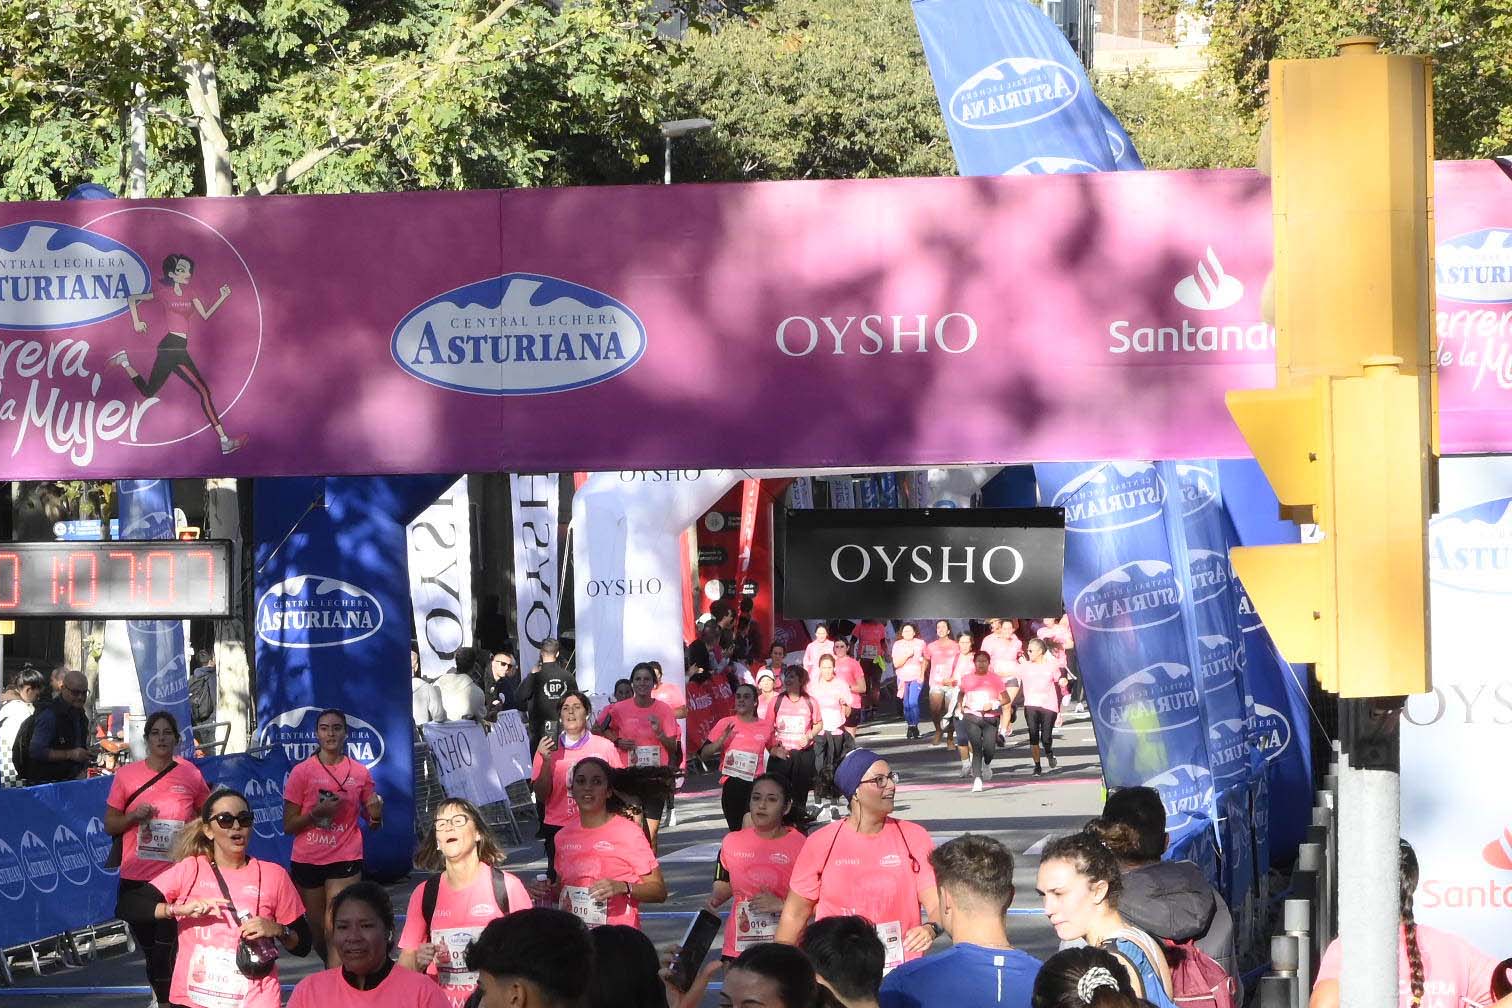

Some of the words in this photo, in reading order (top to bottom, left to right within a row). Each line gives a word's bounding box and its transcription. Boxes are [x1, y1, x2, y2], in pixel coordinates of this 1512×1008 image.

[54, 257, 125, 268] LECHERA
[450, 316, 529, 330] CENTRAL
[537, 314, 617, 327] LECHERA
[775, 312, 978, 357] OYSHO
[412, 321, 626, 365] ASTURIANA
[12, 374, 160, 466] Mujer
[831, 545, 1024, 584] OYSHO
[586, 578, 662, 597] OYSHO
[261, 605, 373, 632] ASTURIANA
[306, 832, 338, 845] SUMA
